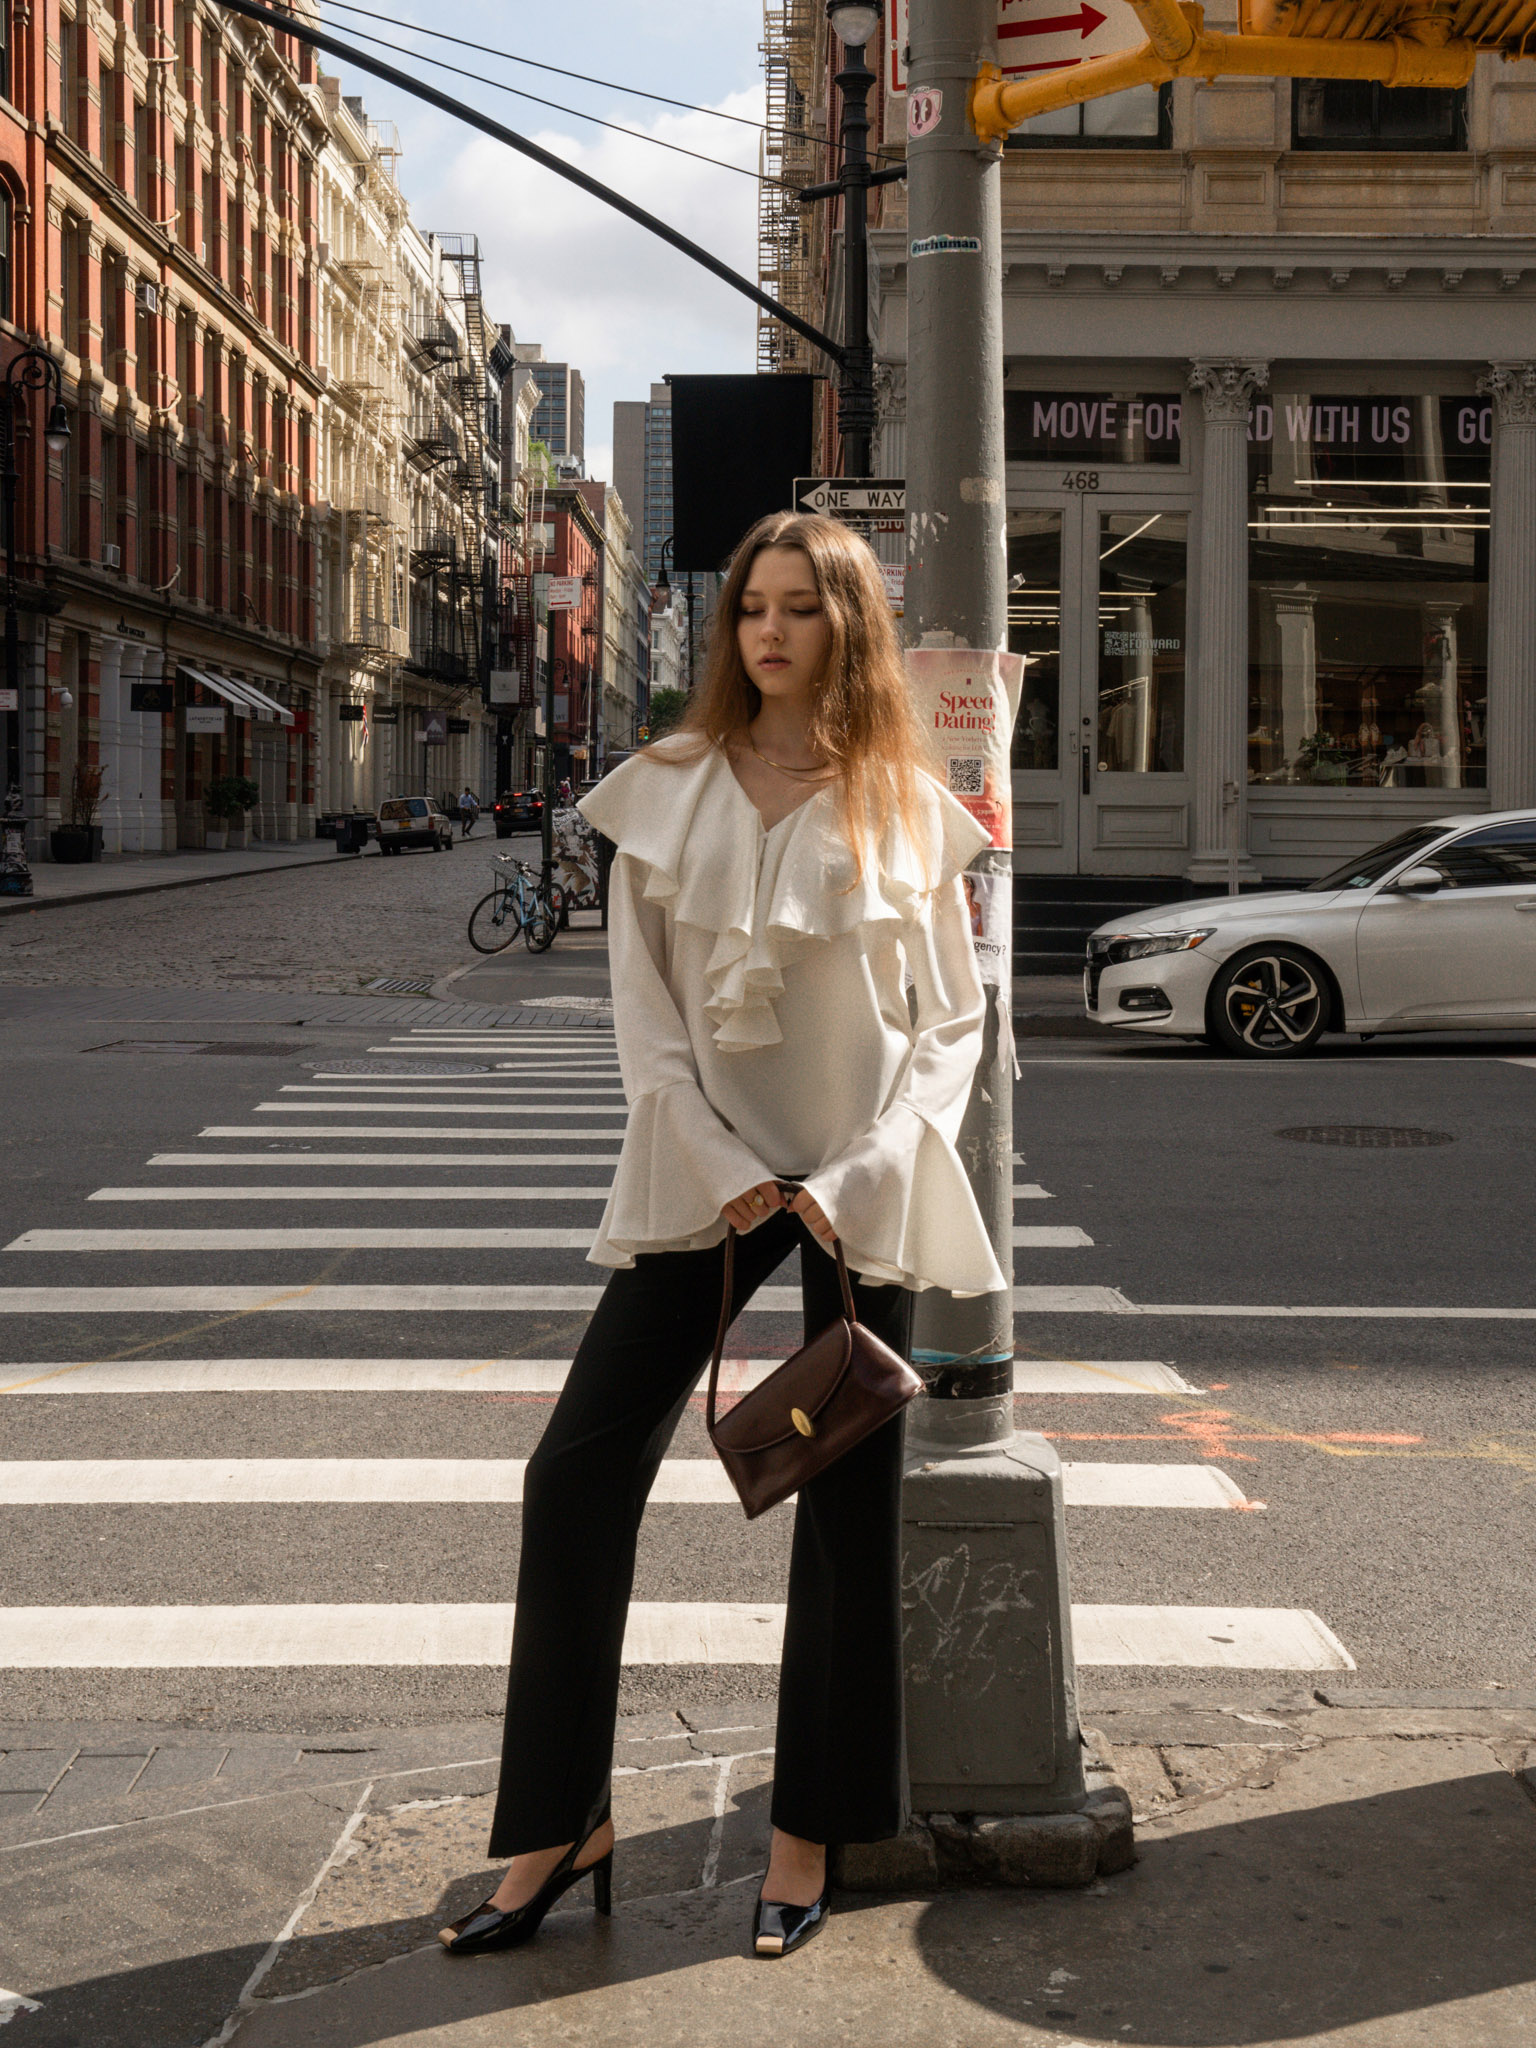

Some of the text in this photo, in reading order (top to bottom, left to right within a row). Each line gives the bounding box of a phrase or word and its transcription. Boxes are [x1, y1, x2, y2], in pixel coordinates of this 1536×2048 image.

[1033, 401, 1117, 439] MOVE
[1285, 405, 1360, 443] WITH
[1371, 406, 1411, 444] US
[1062, 471, 1099, 490] 468
[814, 491, 905, 508] ONE WAY
[1129, 639, 1180, 649] FORWARD
[939, 690, 993, 714] Speed
[934, 711, 996, 735] Dating!
[973, 942, 1006, 956] gency?
